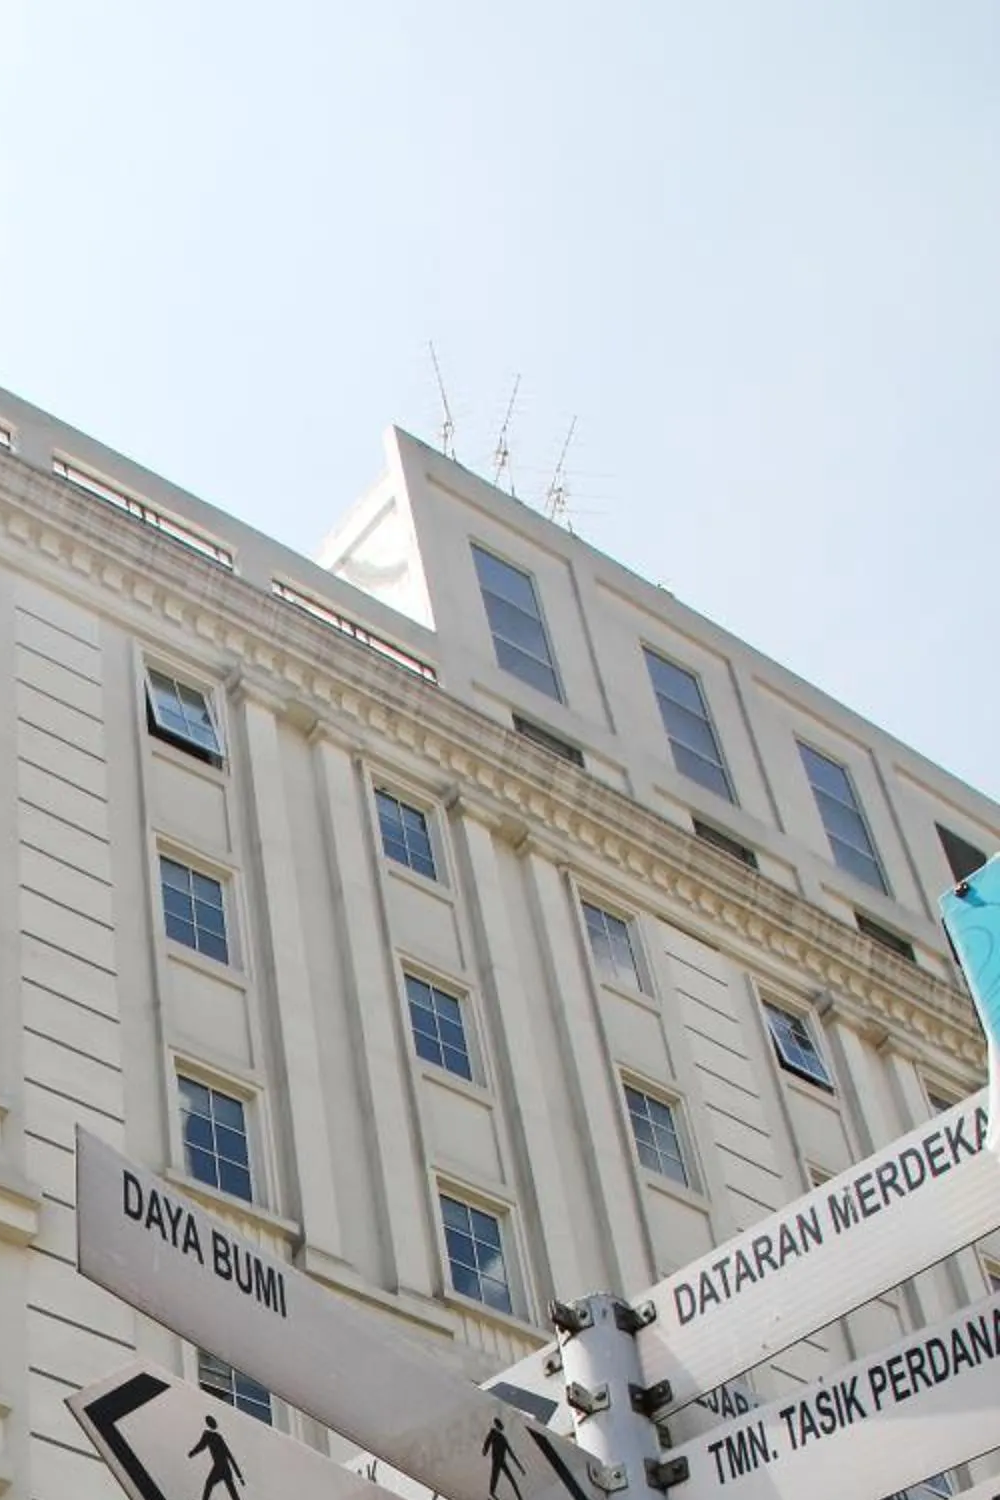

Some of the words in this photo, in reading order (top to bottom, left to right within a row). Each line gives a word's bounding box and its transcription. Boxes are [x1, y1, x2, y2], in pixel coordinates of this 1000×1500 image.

[123, 1169, 204, 1265] DAYA
[212, 1227, 287, 1318] BUMI
[674, 1206, 823, 1326] DATARAN
[708, 1420, 778, 1485] TMN.
[779, 1374, 867, 1450] TASIK
